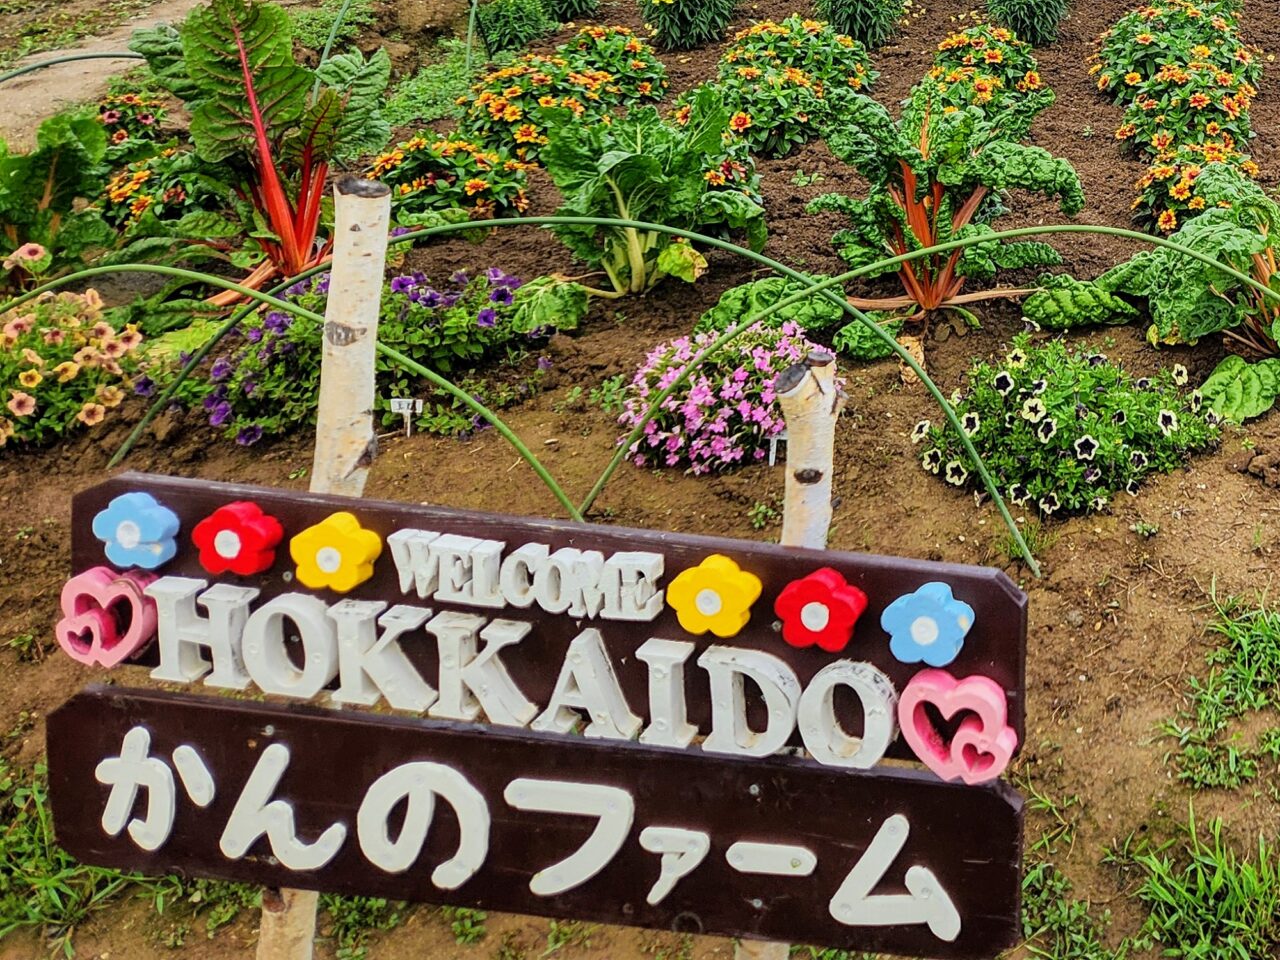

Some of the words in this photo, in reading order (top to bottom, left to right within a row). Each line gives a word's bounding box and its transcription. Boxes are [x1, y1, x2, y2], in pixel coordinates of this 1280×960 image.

[386, 527, 665, 621] WELCOME
[146, 575, 900, 769] HOKKAIDO
[94, 725, 962, 941] かんのファーム
